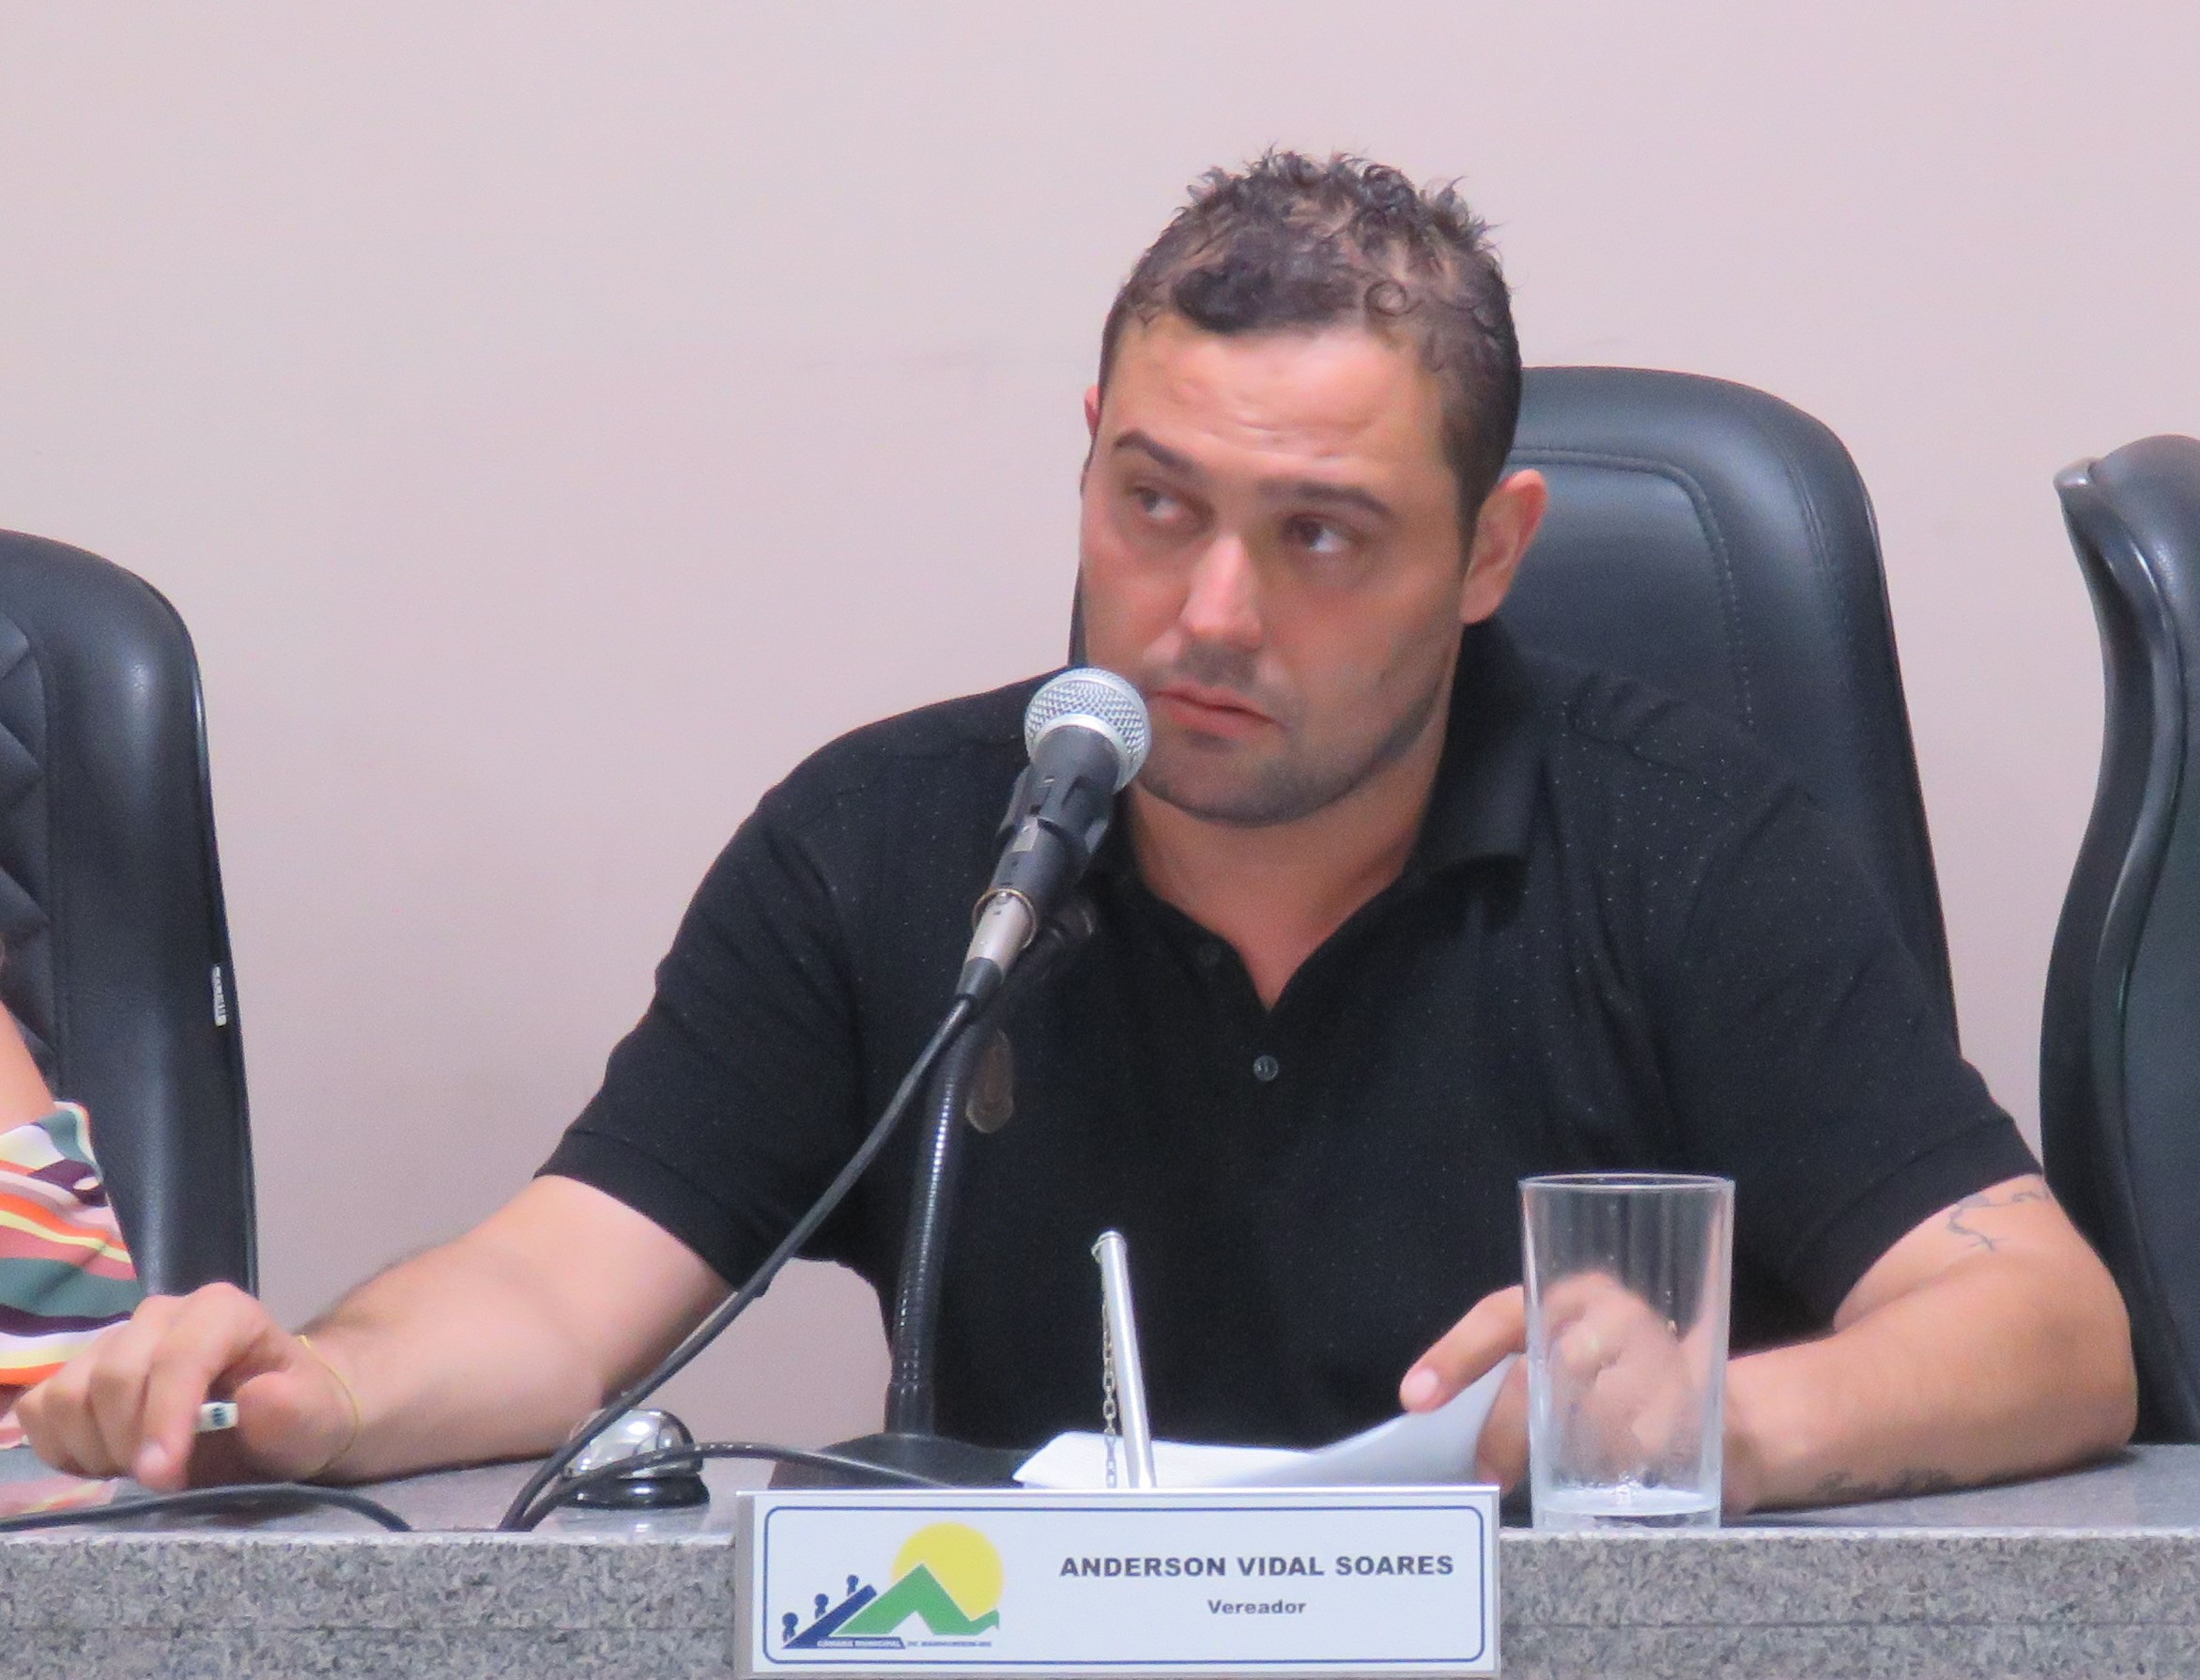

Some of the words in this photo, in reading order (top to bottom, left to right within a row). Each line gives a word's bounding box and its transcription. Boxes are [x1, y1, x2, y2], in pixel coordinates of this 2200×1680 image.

[1060, 1555, 1224, 1577] ANDERSON
[1238, 1555, 1324, 1577] VIDAL
[1336, 1555, 1453, 1577] SOARES
[1208, 1598, 1306, 1613] Vereador
